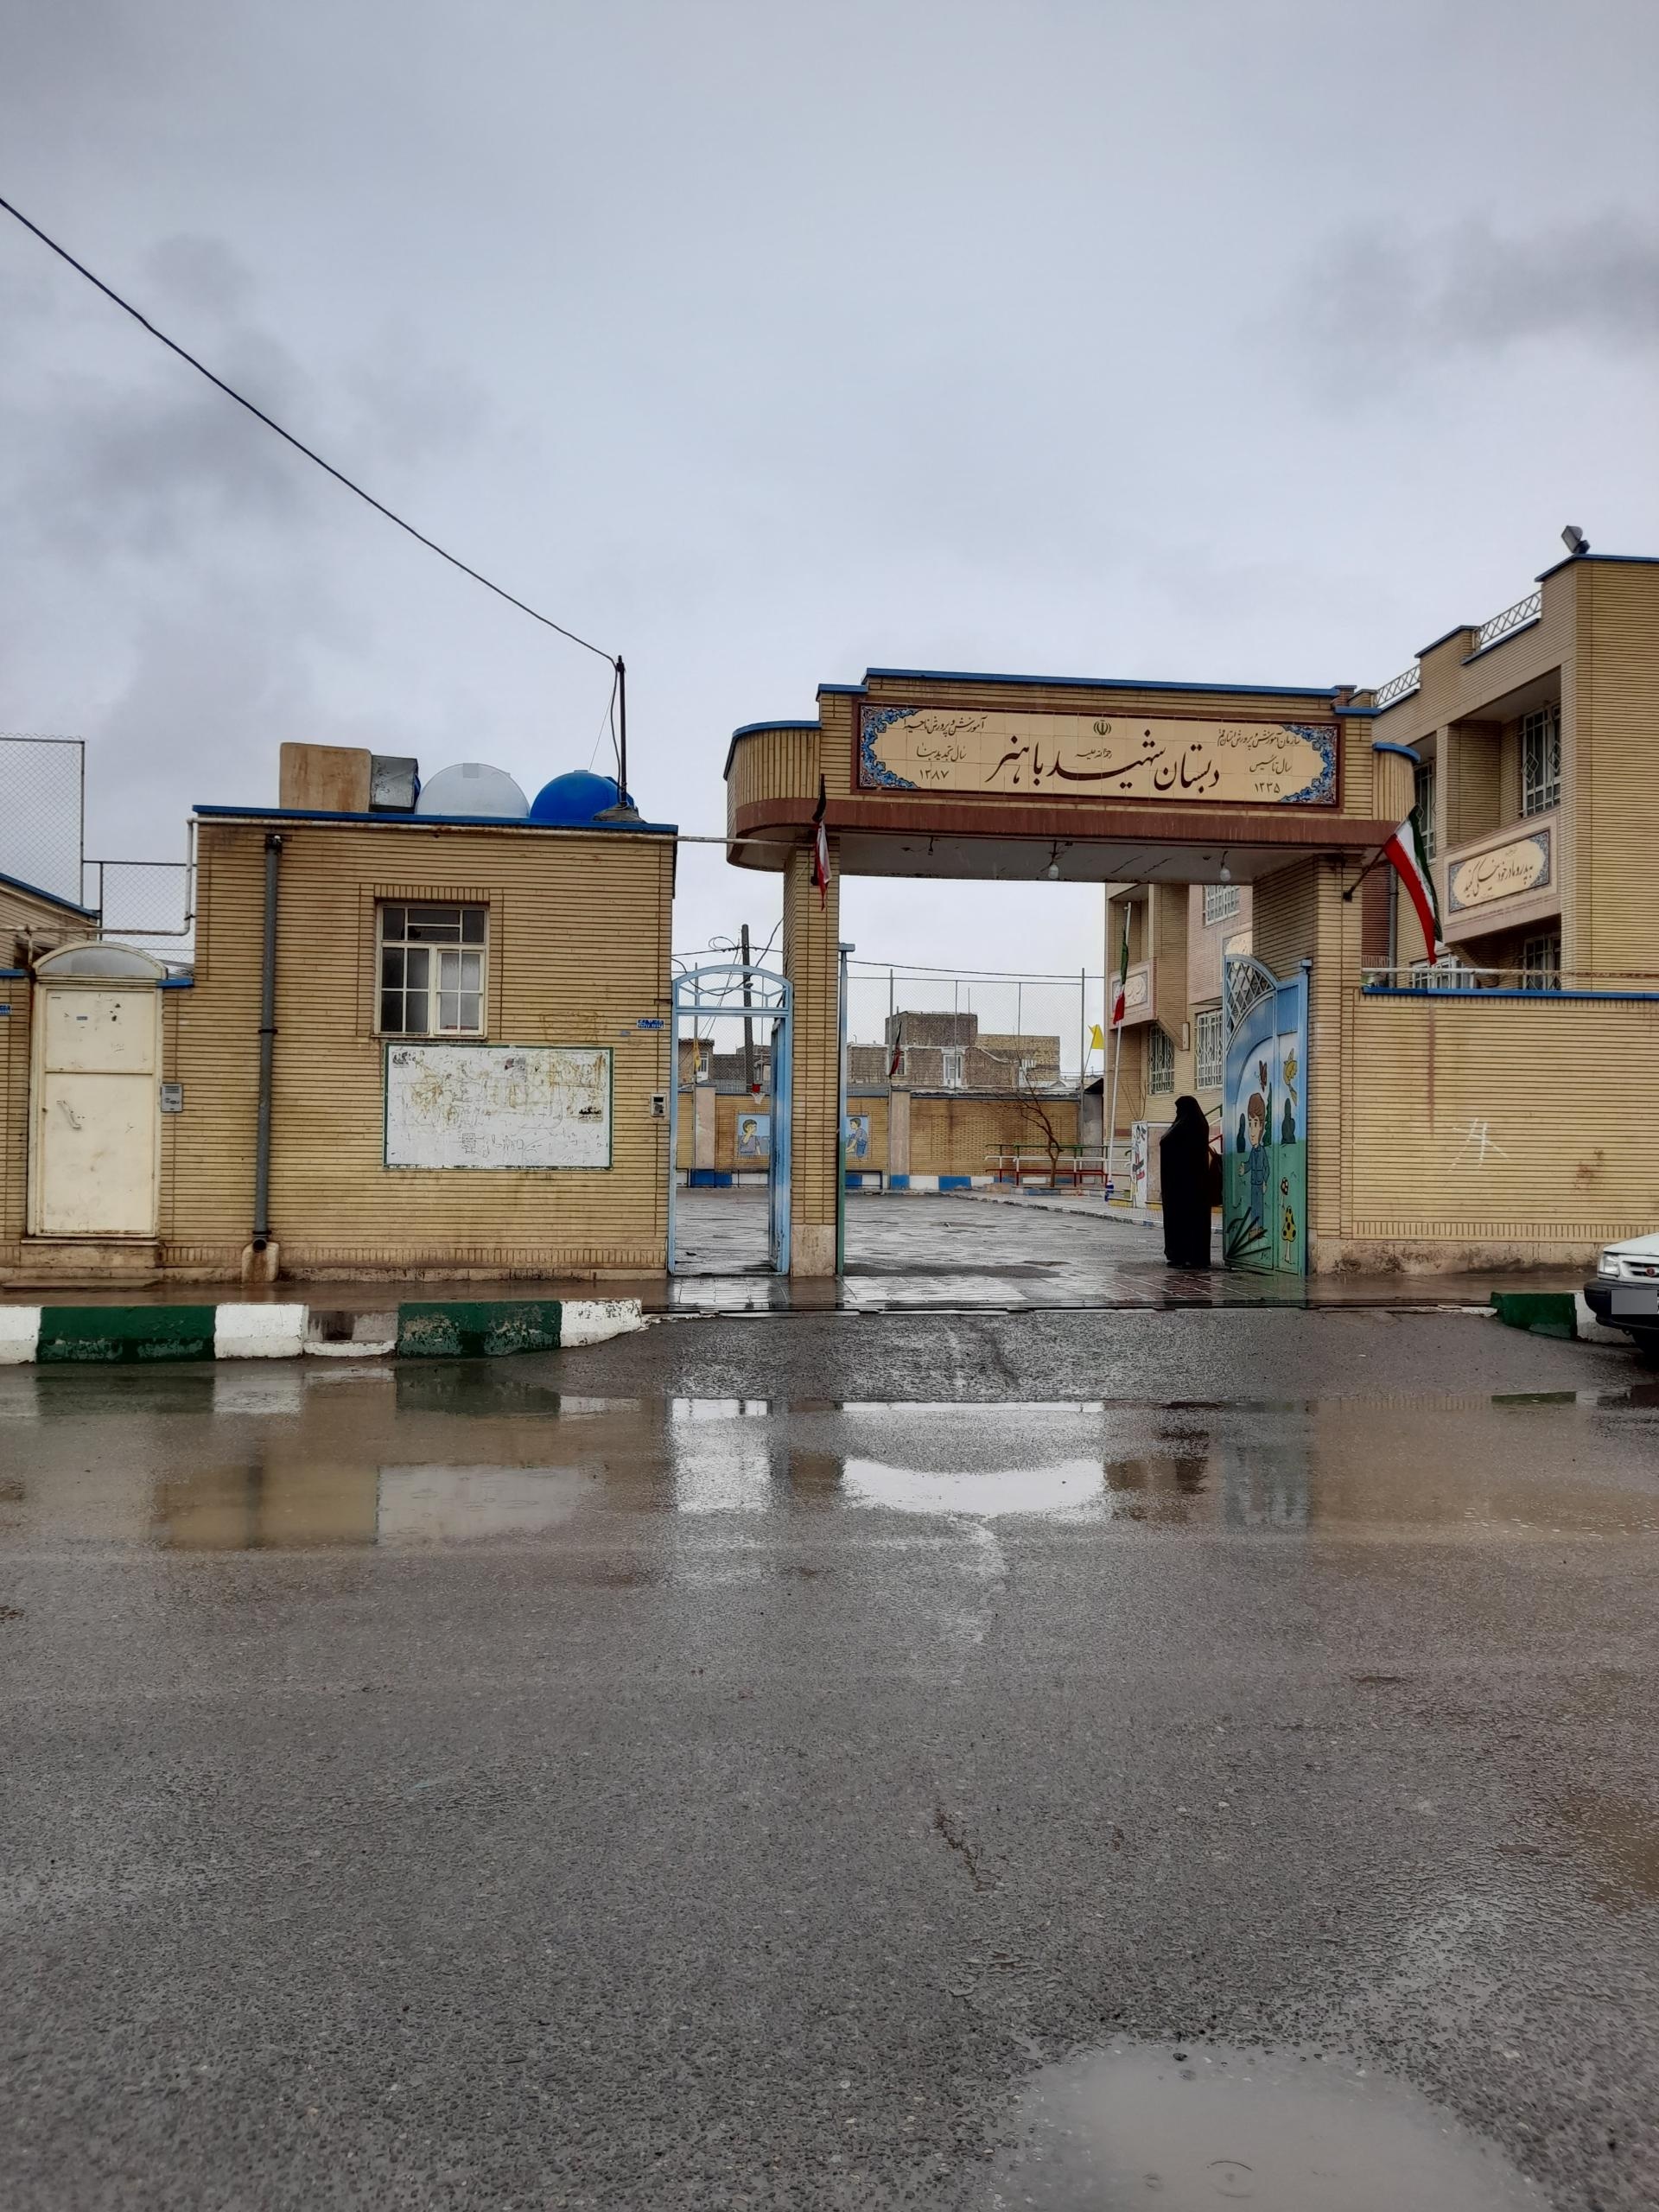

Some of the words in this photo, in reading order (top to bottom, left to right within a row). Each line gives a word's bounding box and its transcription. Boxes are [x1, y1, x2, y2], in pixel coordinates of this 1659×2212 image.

[903, 718, 930, 733] ناحیه
[926, 715, 950, 737] پرورش
[949, 715, 988, 736] آموزش
[1230, 729, 1254, 751] پرورش
[1252, 729, 1284, 748] آموزش
[1276, 734, 1300, 749] سازمان
[917, 743, 937, 761] بنا
[934, 745, 953, 760] تجدید
[950, 745, 967, 762] سال
[984, 735, 1044, 786] باهنر
[1046, 728, 1166, 789] شهید
[1154, 744, 1219, 794] دبستان
[1275, 757, 1293, 775] سال
